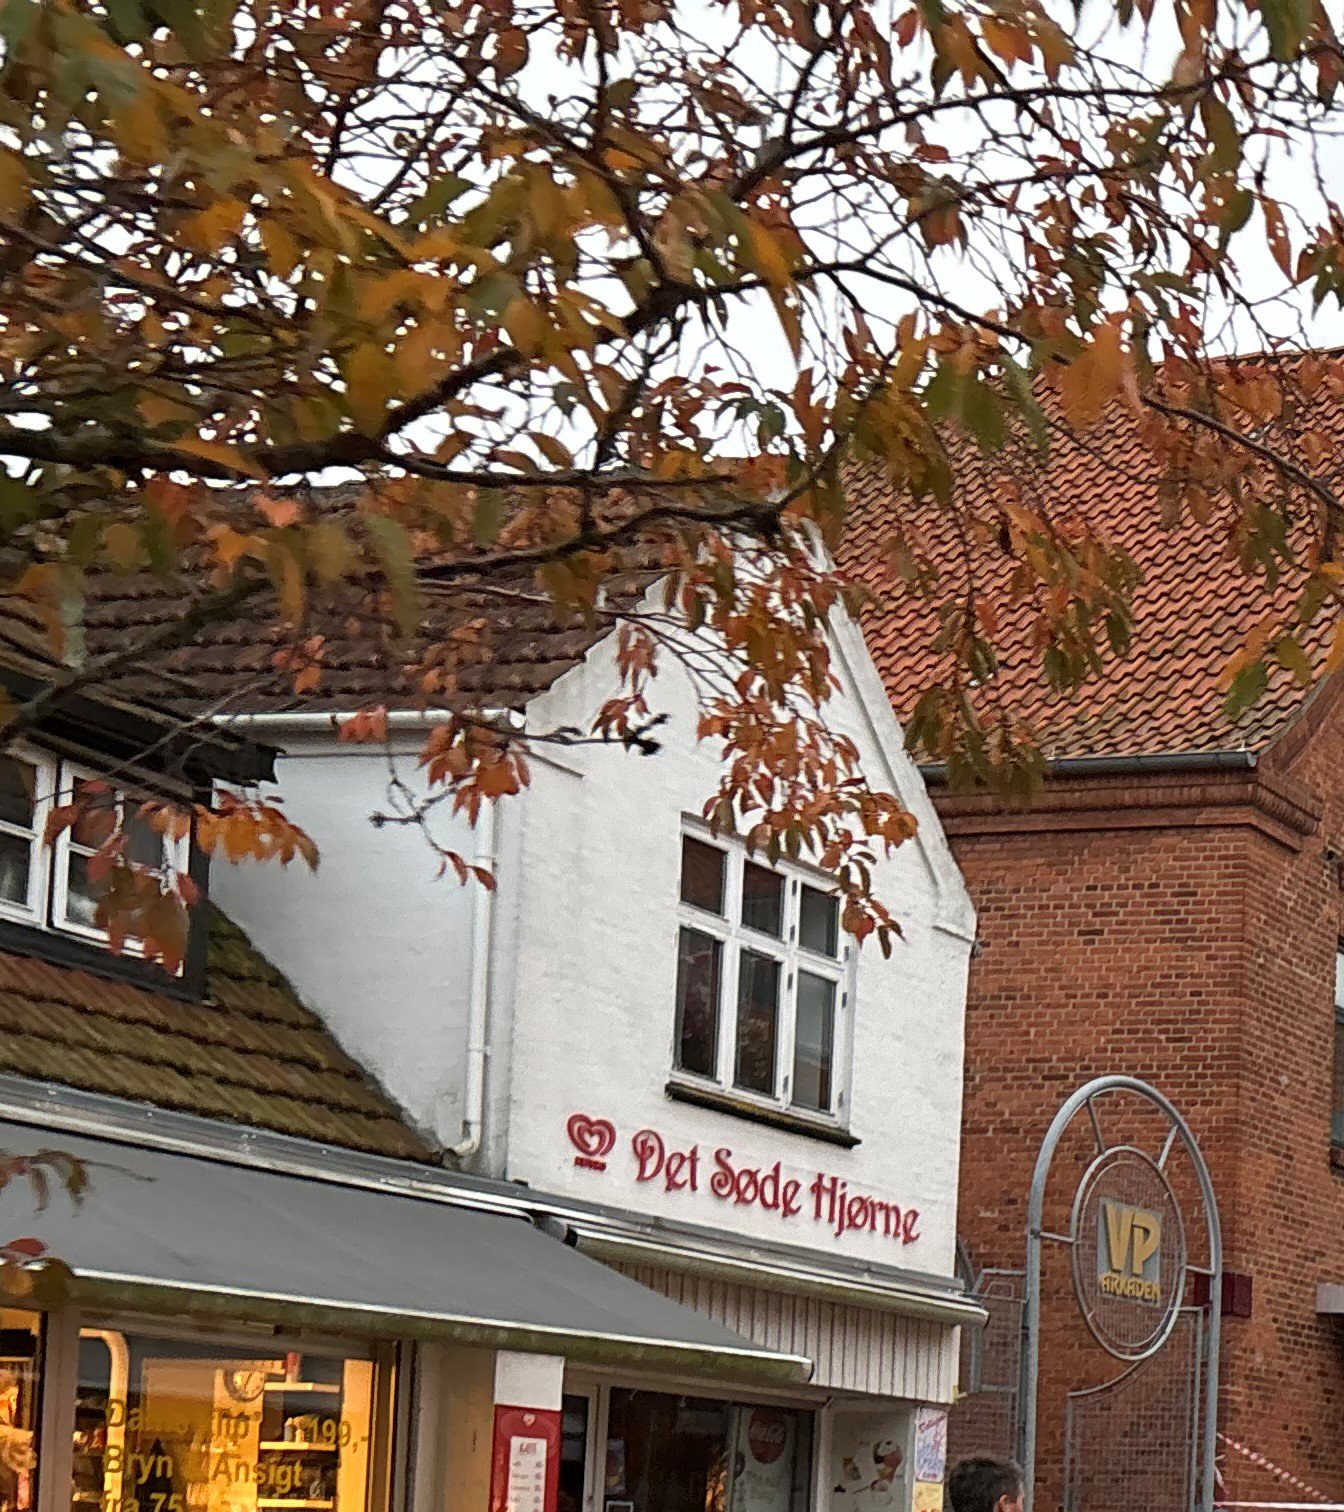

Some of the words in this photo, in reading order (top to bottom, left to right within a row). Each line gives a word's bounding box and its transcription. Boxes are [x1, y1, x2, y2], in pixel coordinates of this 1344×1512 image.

[632, 1129, 700, 1193] Det
[711, 1148, 802, 1219] Søde
[810, 1172, 921, 1245] Hjørne
[1106, 1203, 1160, 1274] VP
[211, 1451, 303, 1495] Ansigt
